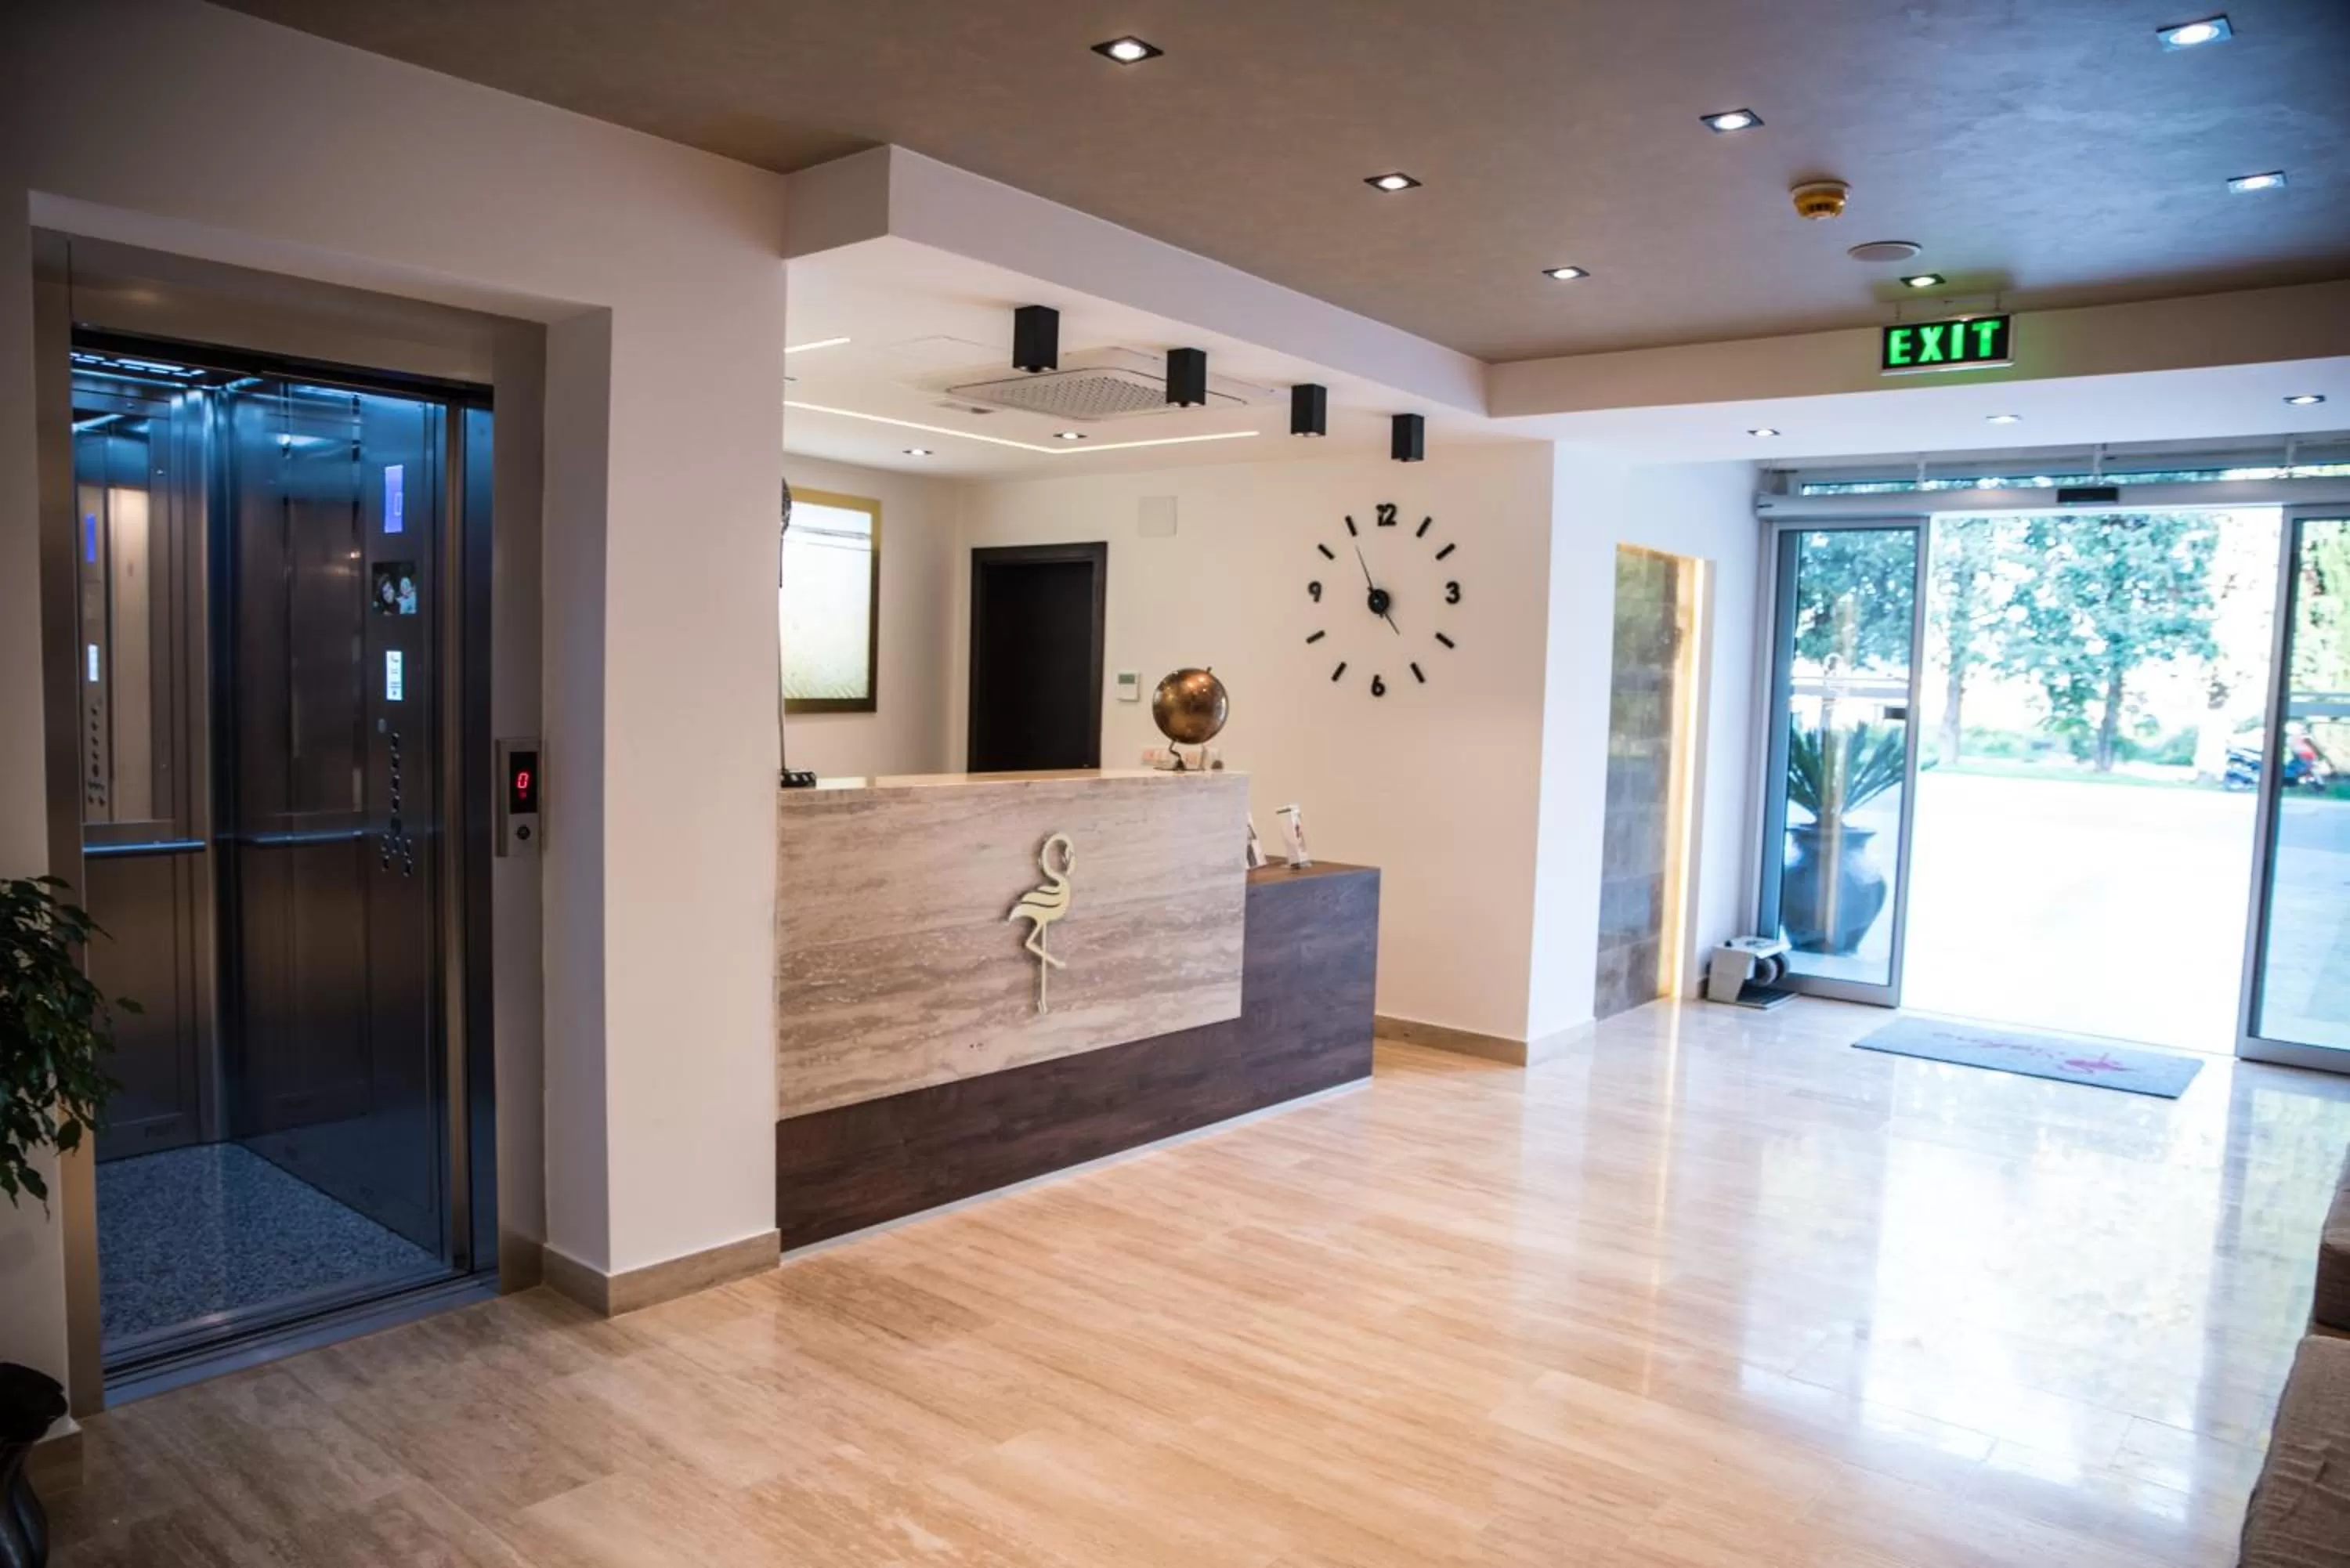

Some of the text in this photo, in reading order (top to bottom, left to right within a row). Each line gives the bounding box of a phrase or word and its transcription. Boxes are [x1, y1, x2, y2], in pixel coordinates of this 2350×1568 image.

[1889, 320, 2002, 365] EXIT
[1376, 503, 1397, 526] 12
[1307, 580, 1322, 603] 9
[1444, 581, 1461, 605] 3
[1371, 674, 1386, 697] 6
[517, 771, 530, 789] 0
